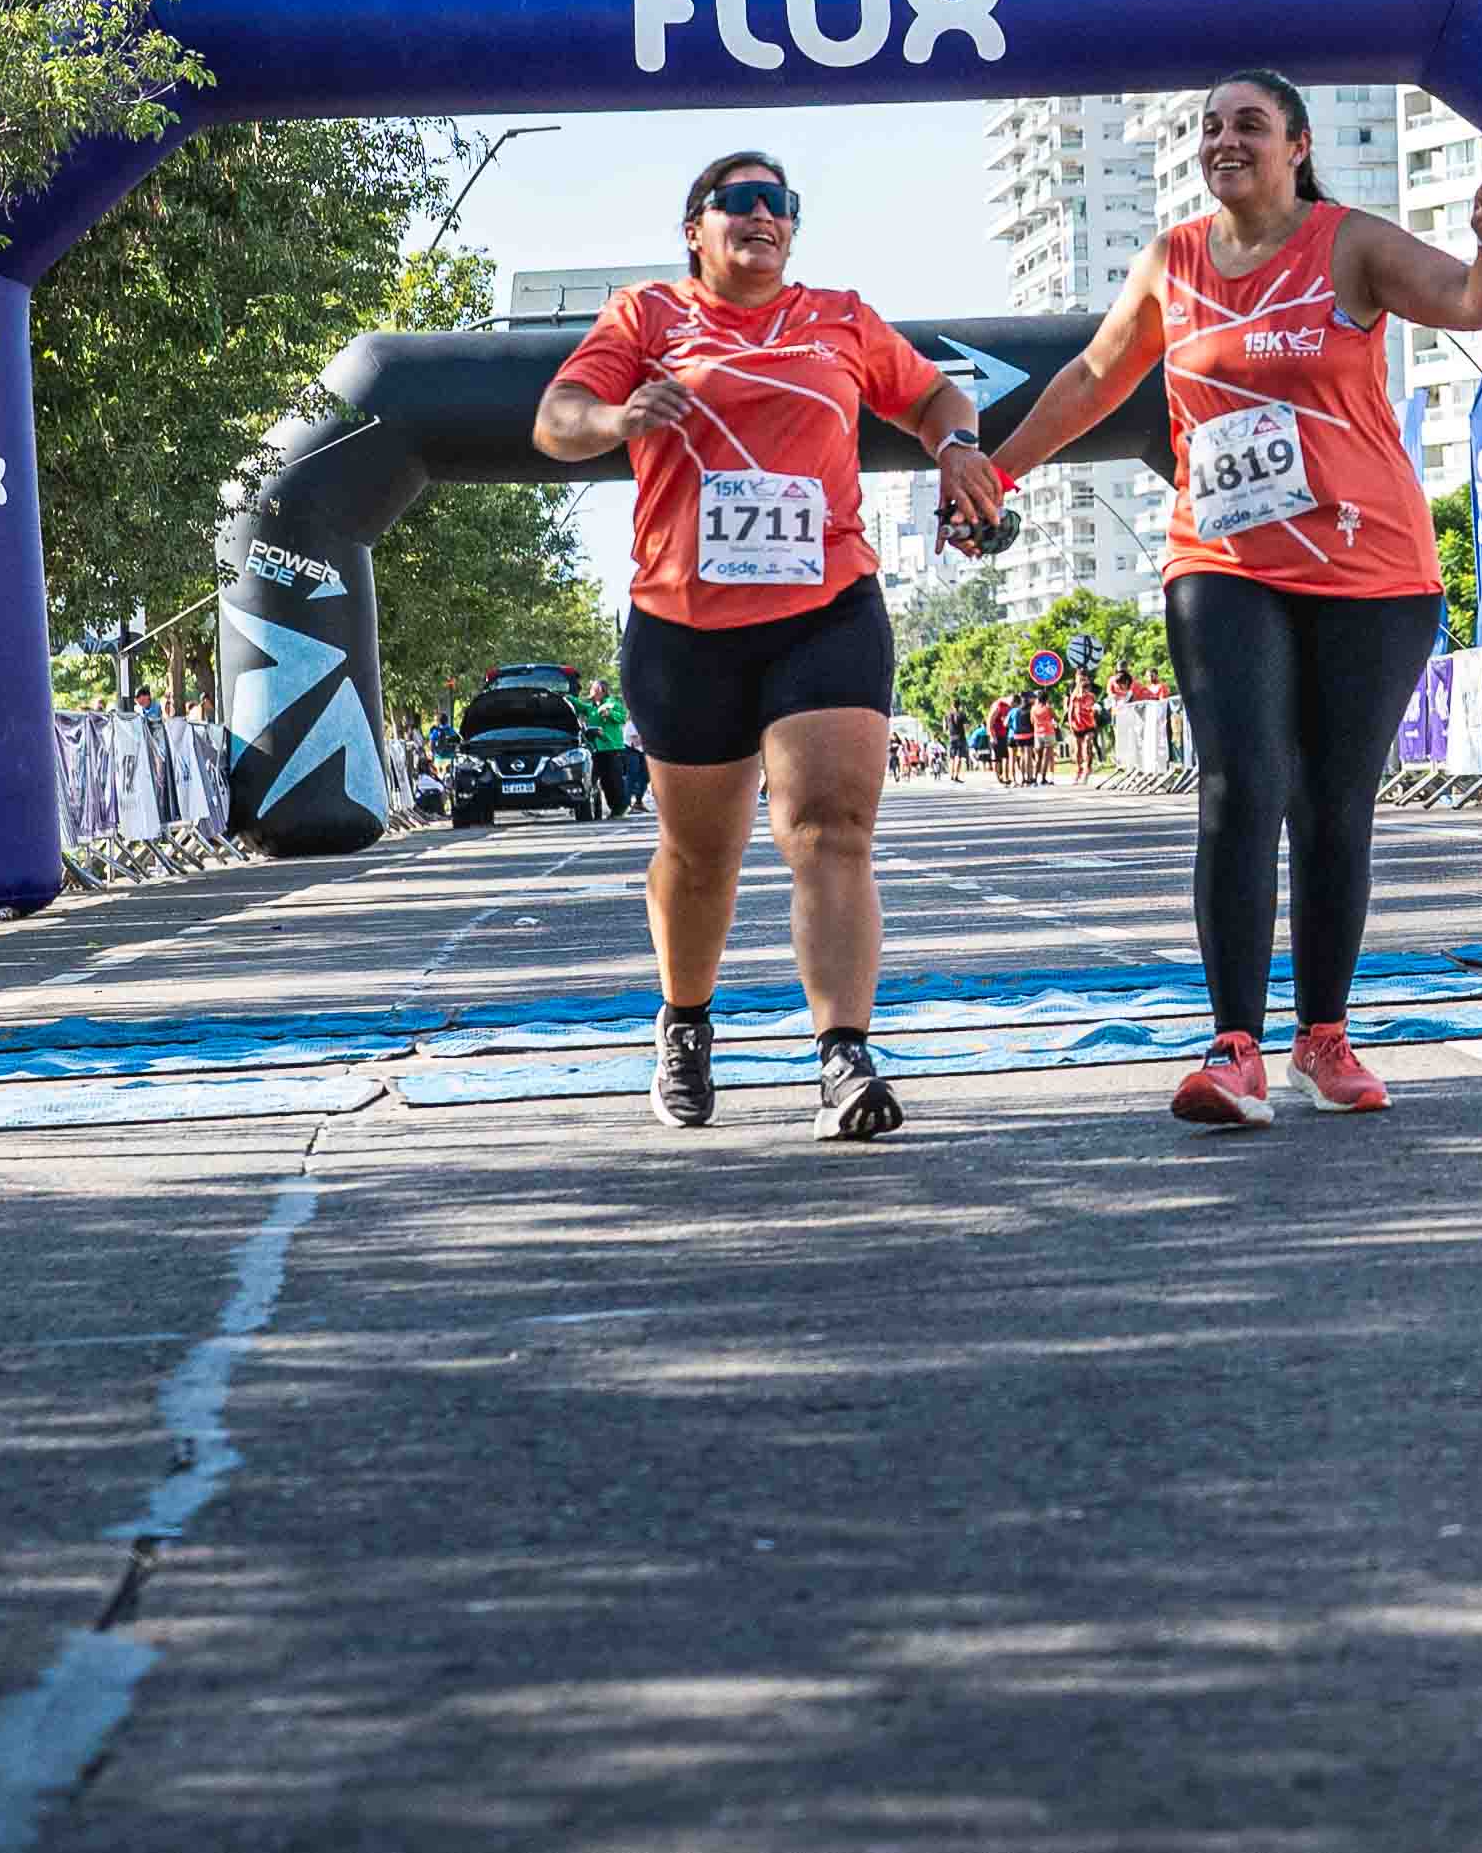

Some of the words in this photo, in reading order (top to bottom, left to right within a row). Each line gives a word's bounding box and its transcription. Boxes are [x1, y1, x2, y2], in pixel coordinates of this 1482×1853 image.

[1243, 331, 1284, 352] 15K
[1193, 439, 1294, 499] 1819
[714, 480, 745, 496] 15K
[705, 506, 815, 543] 1711
[245, 555, 295, 587] ADE
[249, 539, 341, 588] POWER
